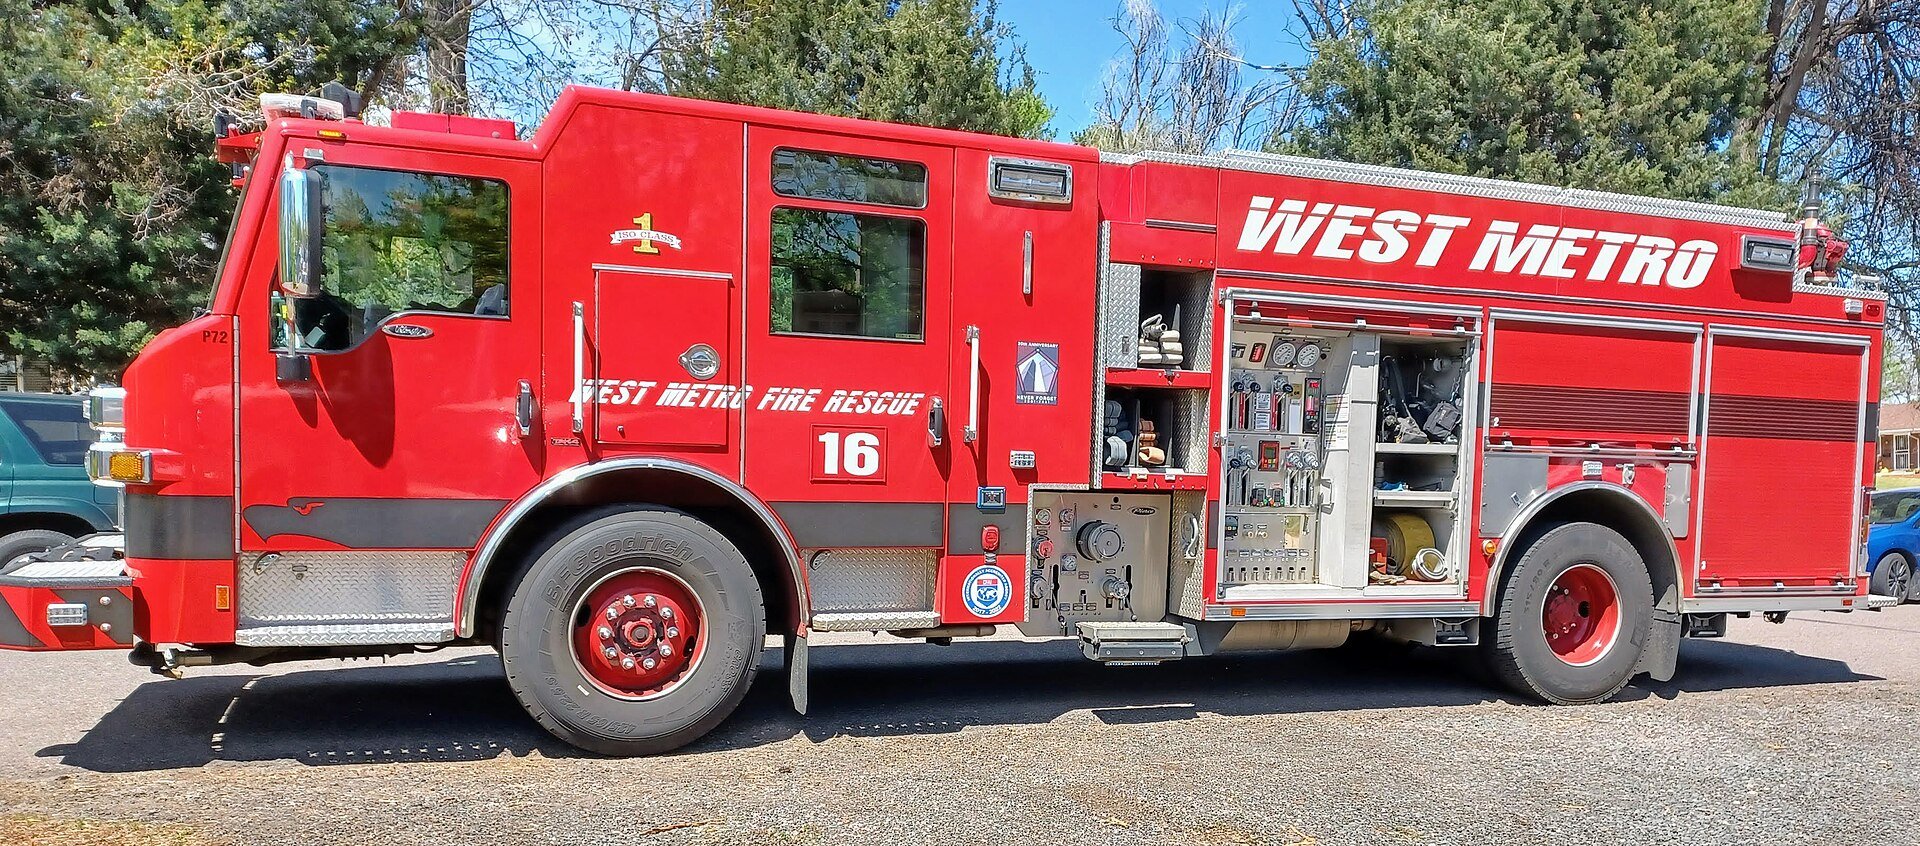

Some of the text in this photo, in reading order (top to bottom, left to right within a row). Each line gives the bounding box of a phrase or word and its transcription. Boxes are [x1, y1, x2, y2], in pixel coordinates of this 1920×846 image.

[617, 231, 674, 243] ISO CLASS
[633, 212, 659, 254] 1
[1236, 195, 1719, 289] WEST METRO
[202, 330, 228, 344] P72
[568, 378, 926, 416] WEST METRO FIRE RESCUE
[1493, 416, 1500, 427] 2
[818, 431, 880, 476] 16
[542, 531, 694, 608] BFGoodrich
